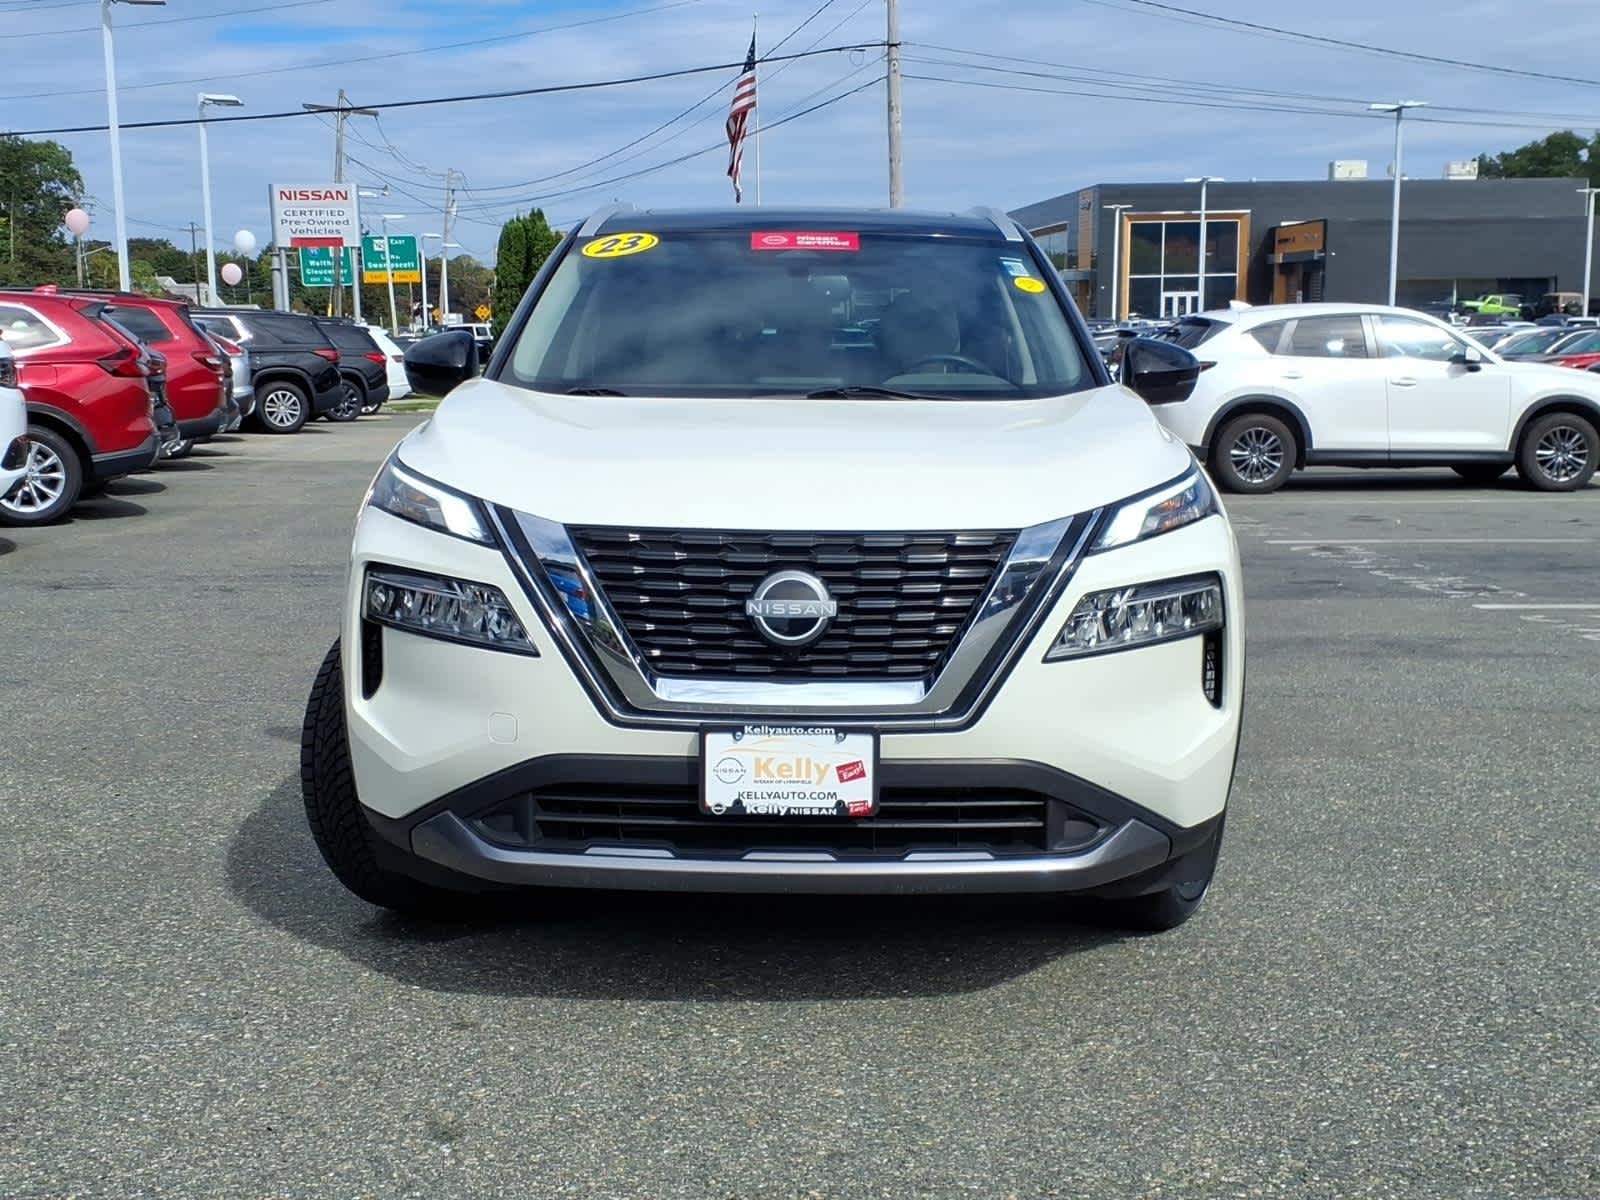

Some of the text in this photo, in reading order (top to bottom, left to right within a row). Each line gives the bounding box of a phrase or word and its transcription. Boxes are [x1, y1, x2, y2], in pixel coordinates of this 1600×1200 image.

[280, 190, 348, 201] NISSAN
[283, 209, 345, 217] CERTIFIED
[289, 227, 342, 235] Vehicles
[594, 236, 644, 254] 23
[309, 259, 344, 267] Walth
[749, 603, 833, 615] NISSAN
[744, 725, 835, 737] Kellyauto.com
[754, 757, 832, 785] Kelly
[738, 791, 837, 800] KELLYAUTO.COM
[746, 803, 837, 815] Kelly NISSAN
